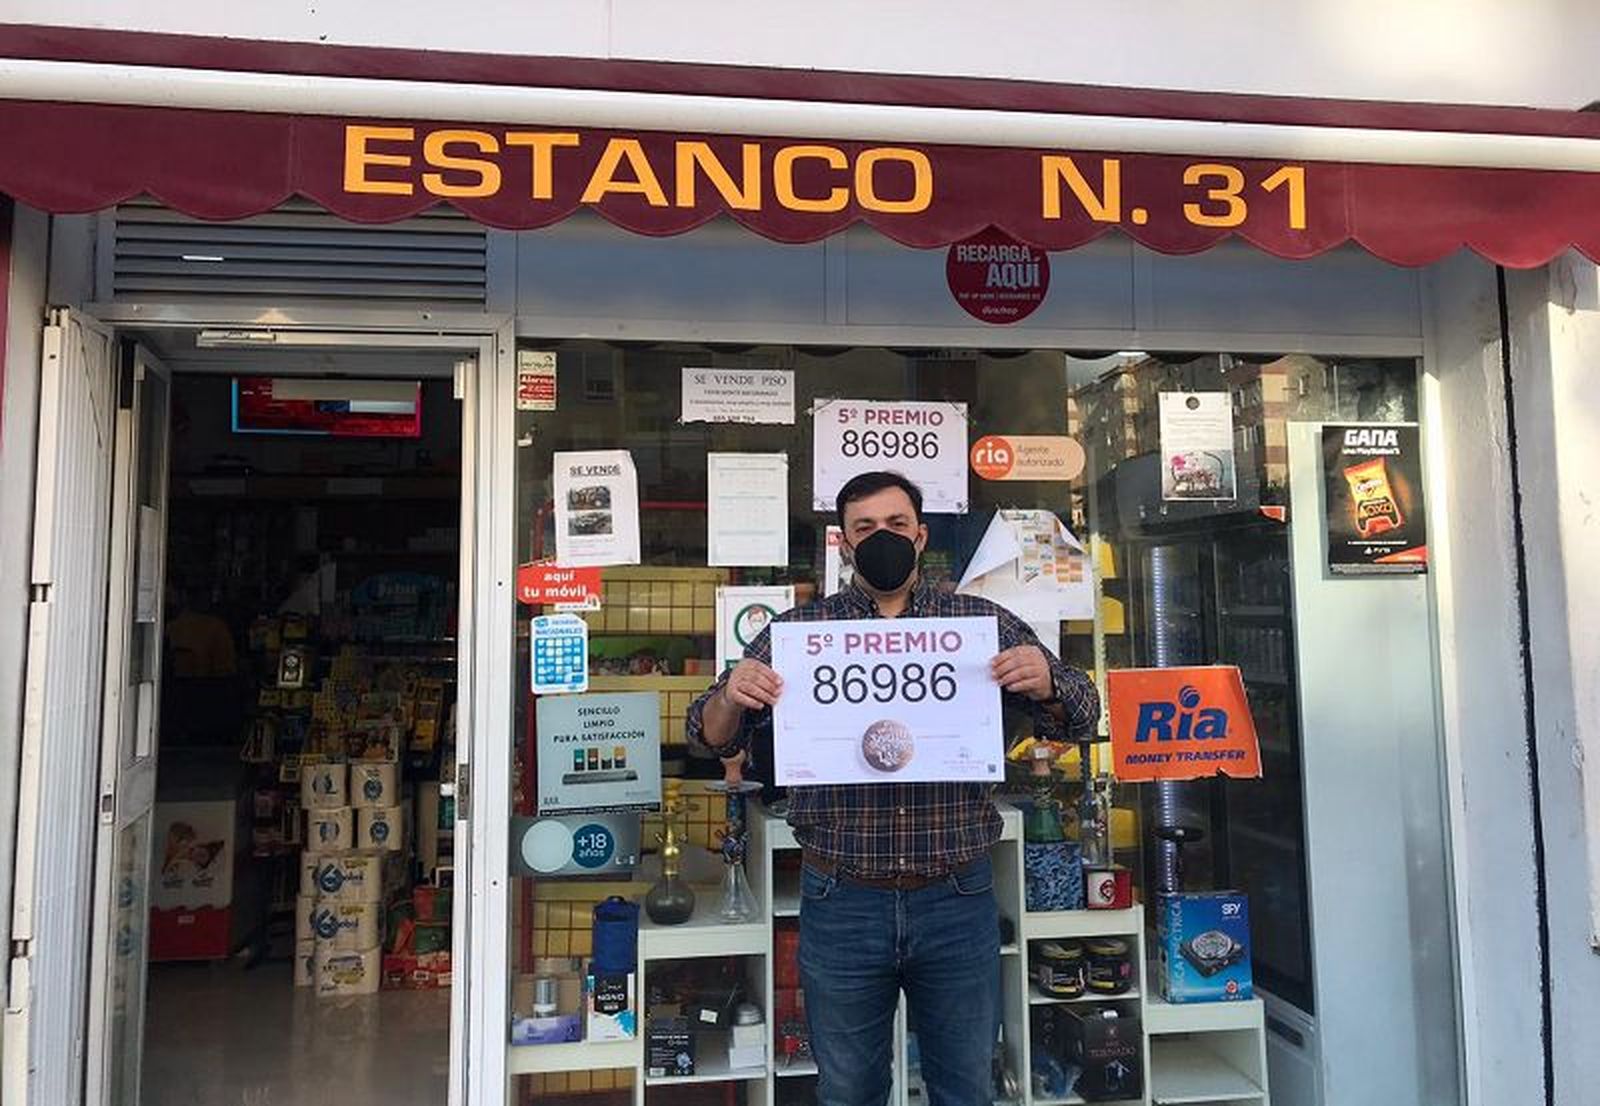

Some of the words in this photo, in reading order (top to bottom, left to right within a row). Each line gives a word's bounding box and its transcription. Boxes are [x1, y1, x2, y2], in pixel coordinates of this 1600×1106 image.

[343, 125, 934, 214] ESTANCO
[1042, 155, 1147, 224] N.
[1182, 163, 1307, 230] 31
[957, 244, 1032, 263] RECARGA
[986, 257, 1041, 290] AQUÍ
[694, 375, 707, 385] SE
[713, 375, 755, 386] VENDE
[761, 376, 788, 387] PISO
[864, 409, 944, 427] PREMIO
[841, 429, 940, 459] 86986
[1344, 429, 1399, 447] GANA
[975, 441, 1009, 465] ria
[569, 466, 582, 476] SE
[584, 464, 621, 476] VENDE
[543, 569, 576, 583] aquí
[523, 586, 540, 598] tu
[545, 584, 587, 598] móvil
[844, 630, 963, 655] PREMIO
[813, 662, 958, 705] 86986
[577, 706, 621, 717] SENCILLO
[1135, 685, 1229, 744] Ria
[583, 719, 616, 729] LIMPIO
[553, 735, 579, 744] PURA
[581, 729, 646, 742] SATISFACCIÓN
[1125, 752, 1174, 765] MONEY
[1176, 749, 1247, 763] TRANSFER
[577, 832, 608, 849] +18
